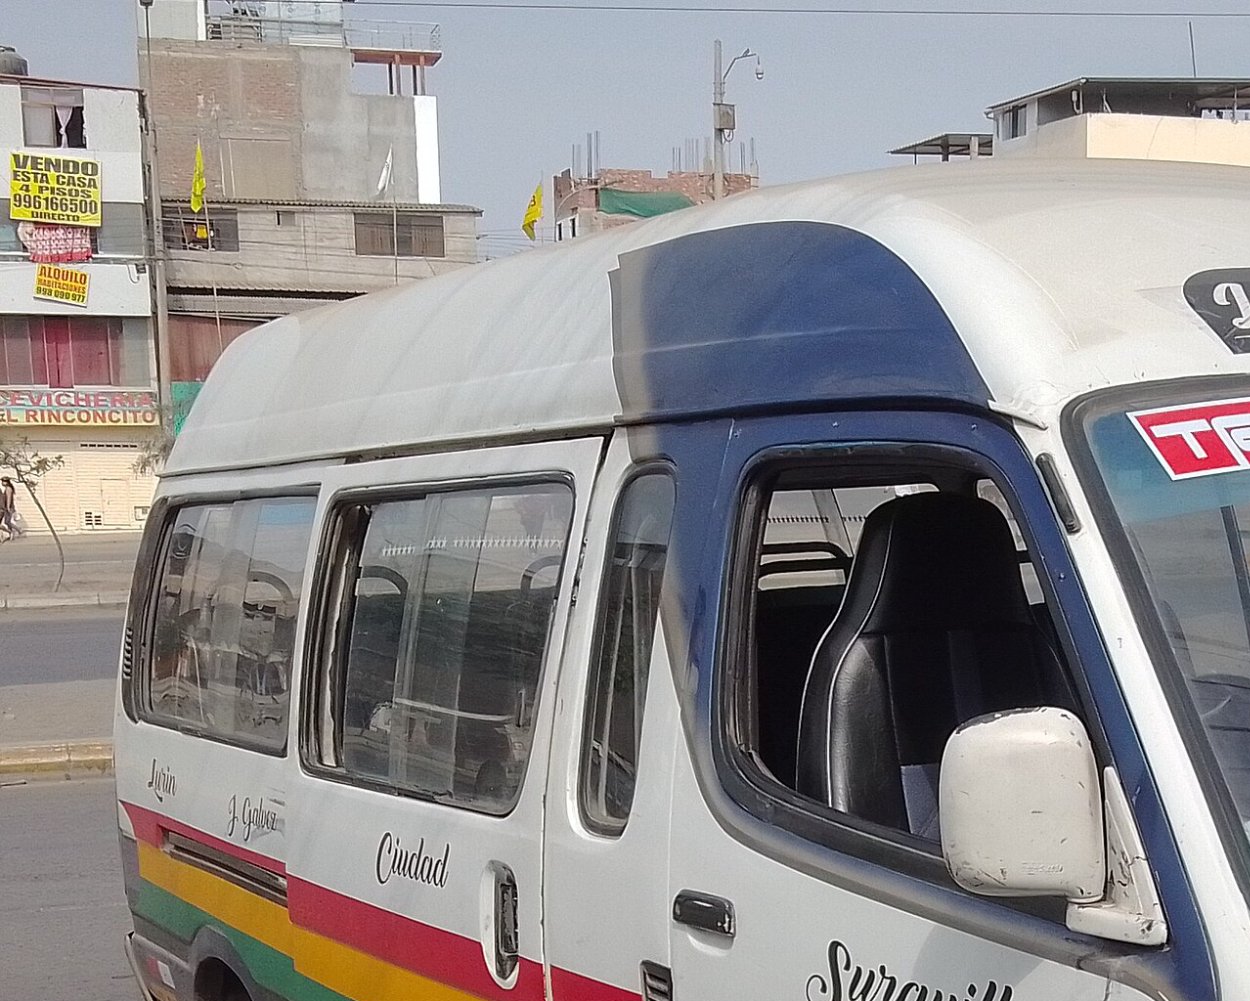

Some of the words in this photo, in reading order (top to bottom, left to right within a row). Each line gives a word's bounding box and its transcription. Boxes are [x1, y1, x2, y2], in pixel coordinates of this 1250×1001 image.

[12, 154, 98, 176] VENDO
[13, 170, 50, 184] ESTA
[56, 174, 97, 189] CASA
[20, 184, 31, 193] 4
[38, 185, 92, 199] PISOS
[13, 193, 98, 214] 996166500
[31, 211, 80, 222] DIRECTO
[25, 409, 156, 424] RINCONCITO
[147, 759, 177, 802] Lurin
[376, 831, 450, 888] Ciudad
